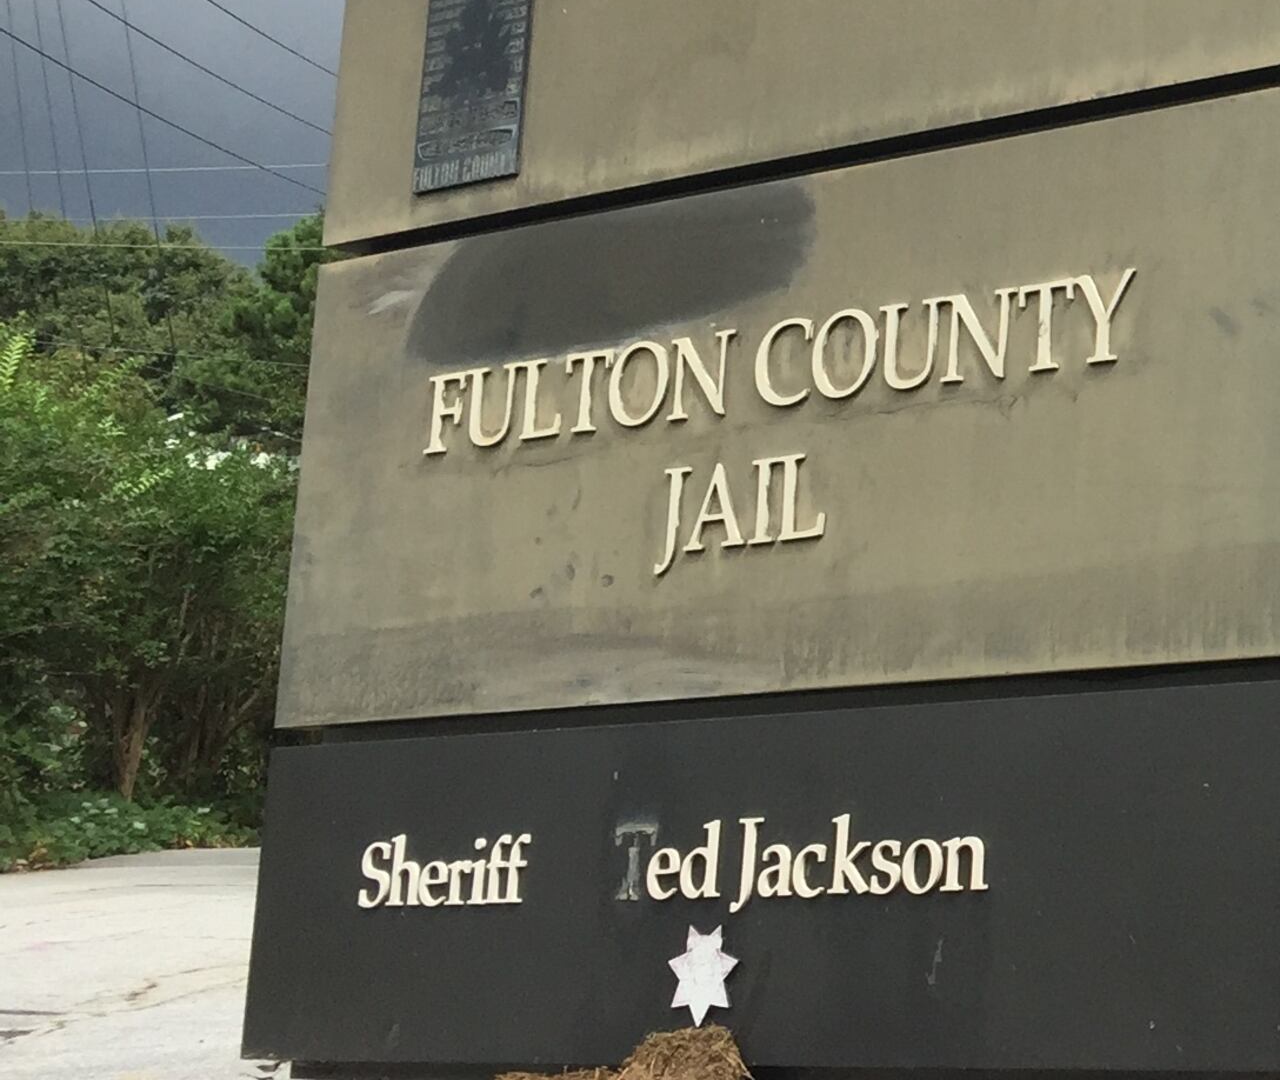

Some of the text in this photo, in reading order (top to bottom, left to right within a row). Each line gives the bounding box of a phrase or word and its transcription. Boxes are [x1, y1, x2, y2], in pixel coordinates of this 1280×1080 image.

[422, 268, 1137, 455] FULTON COUNTY
[653, 453, 826, 576] JAIL
[357, 814, 989, 913] Sheriff Ted Jackson
